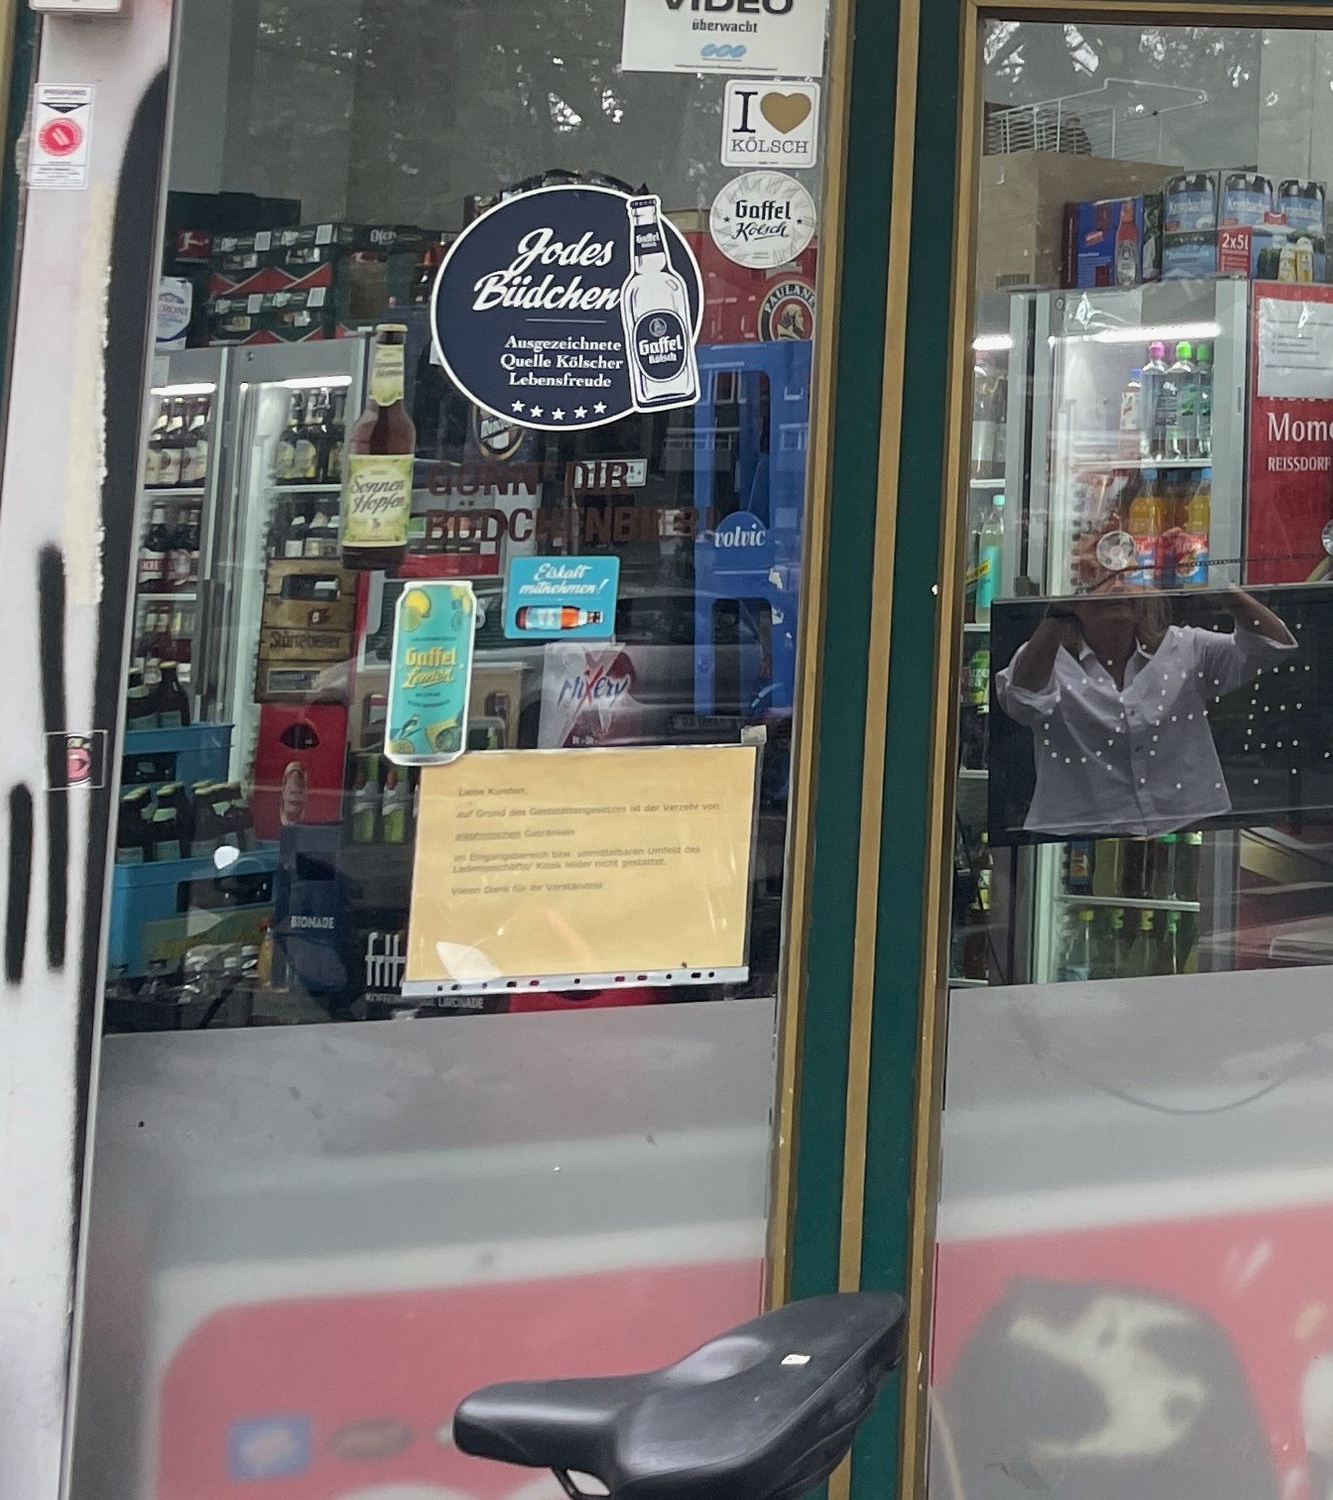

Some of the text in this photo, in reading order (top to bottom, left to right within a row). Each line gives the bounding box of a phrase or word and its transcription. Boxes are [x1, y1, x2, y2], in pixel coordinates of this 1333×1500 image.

[692, 20, 758, 33] überwacht
[732, 91, 758, 133] I
[731, 135, 808, 154] KÖLSCH
[735, 199, 791, 221] Gaffel
[507, 228, 615, 276] Jodes
[472, 270, 622, 312] Büdchen
[765, 284, 816, 314] PAULAN
[504, 335, 622, 353] Ausgezeichnete
[639, 334, 683, 356] Gaffel
[501, 354, 623, 370] Quelle Kölscher
[509, 372, 611, 387] Lebensfreude
[1267, 456, 1332, 472] REISSDORF
[714, 523, 767, 548] volvic
[533, 562, 593, 582] Eiskalt
[519, 578, 610, 596] mitnehmen!
